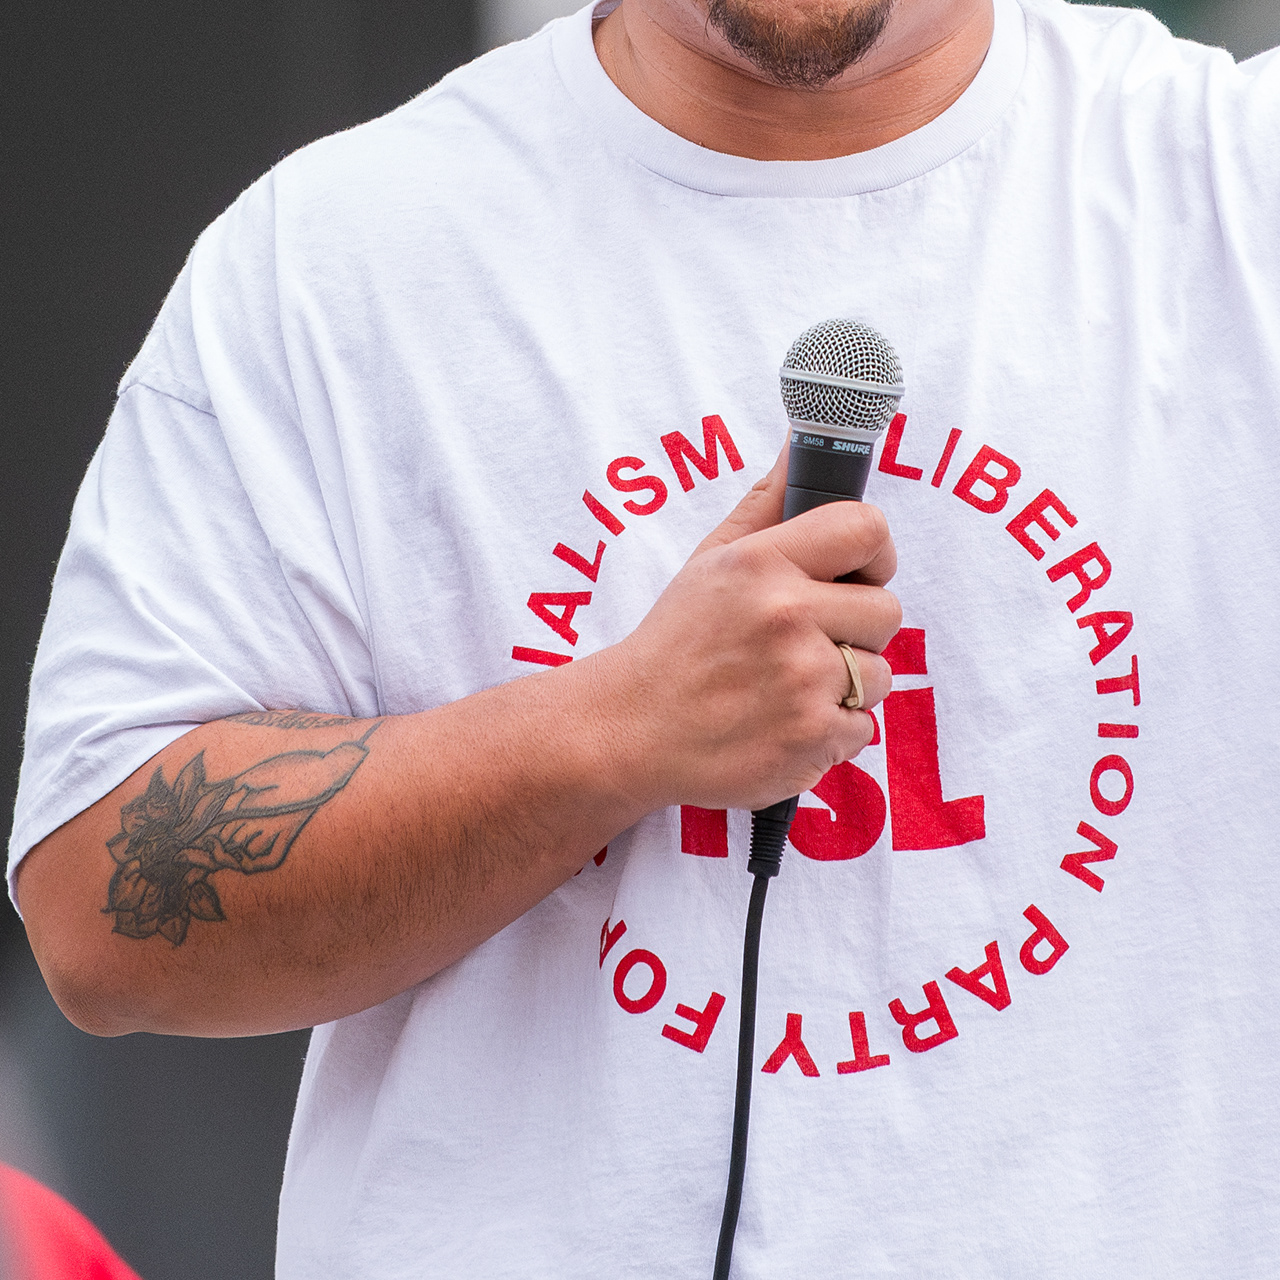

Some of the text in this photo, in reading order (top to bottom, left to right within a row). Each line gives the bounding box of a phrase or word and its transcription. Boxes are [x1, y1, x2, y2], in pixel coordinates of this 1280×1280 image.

[511, 414, 745, 668] IALISM
[803, 435, 825, 447] SM58
[832, 440, 871, 455] SHURE
[680, 627, 987, 862] SL
[877, 411, 1141, 893] LIBERATION
[761, 904, 1070, 1078] PARTY
